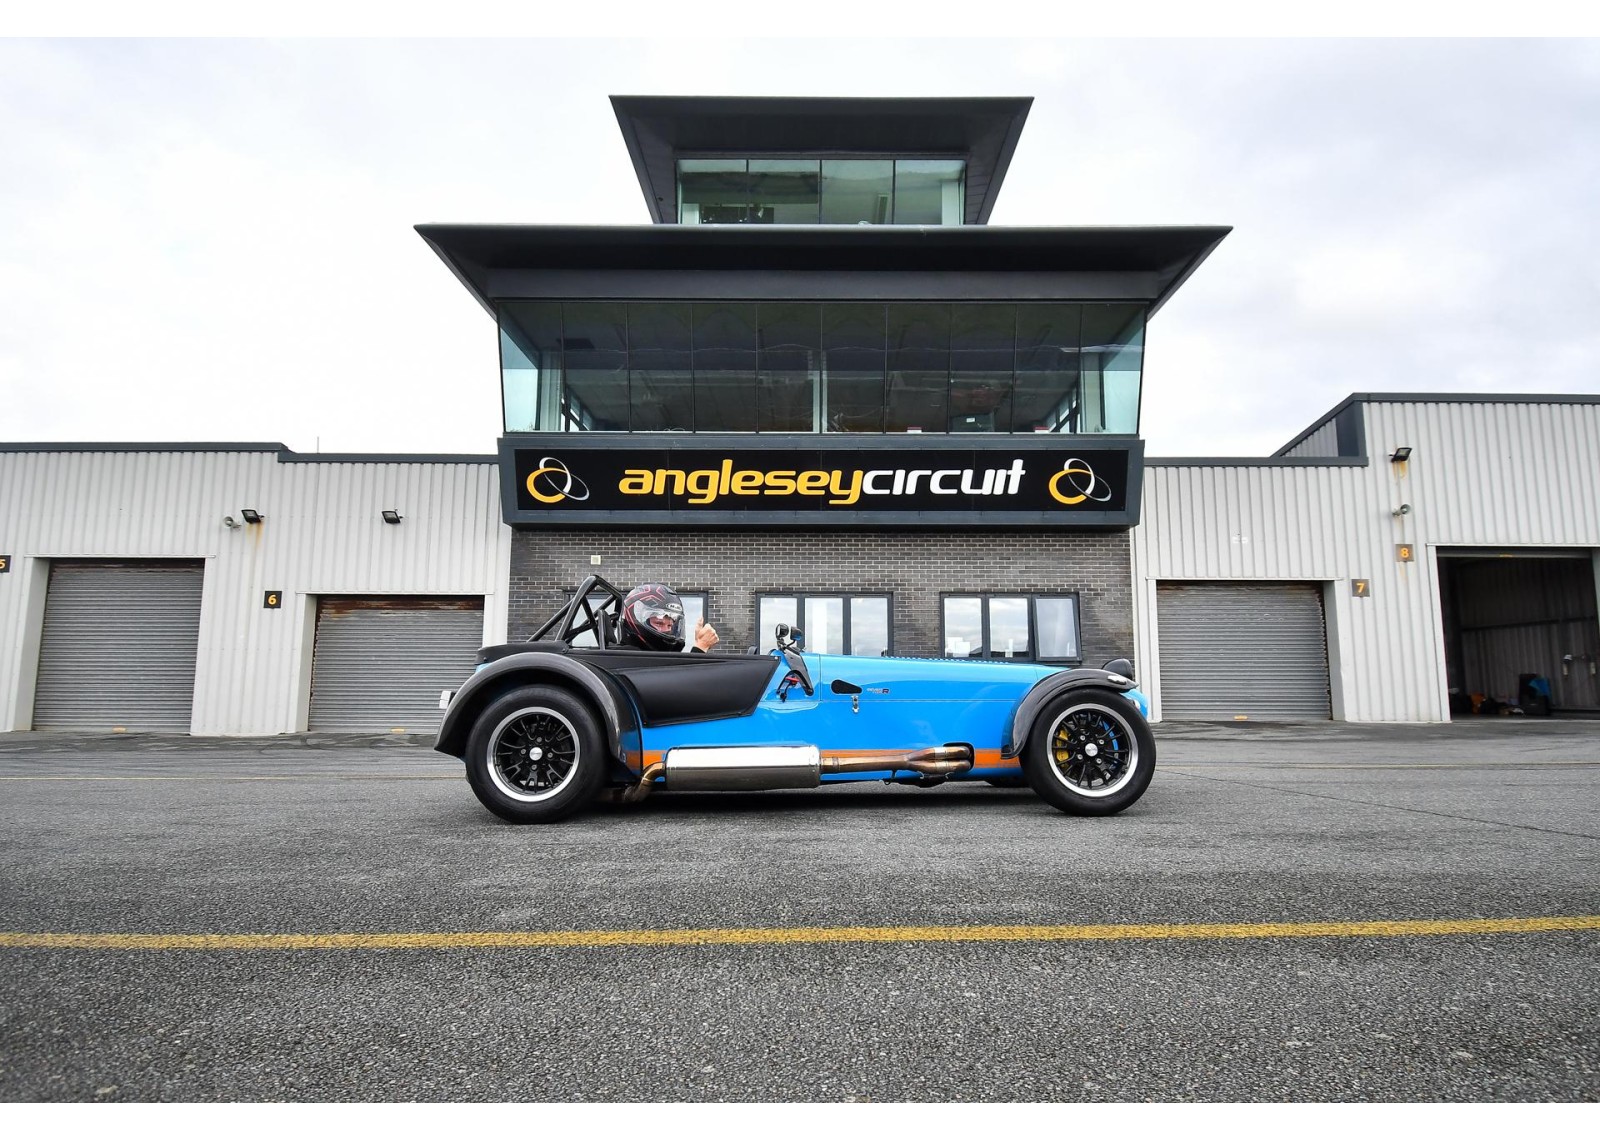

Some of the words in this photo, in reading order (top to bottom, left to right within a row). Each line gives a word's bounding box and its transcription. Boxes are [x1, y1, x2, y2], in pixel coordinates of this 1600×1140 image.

[1400, 547, 1409, 558] 8
[1356, 582, 1365, 593] 7
[268, 594, 277, 605] 6
